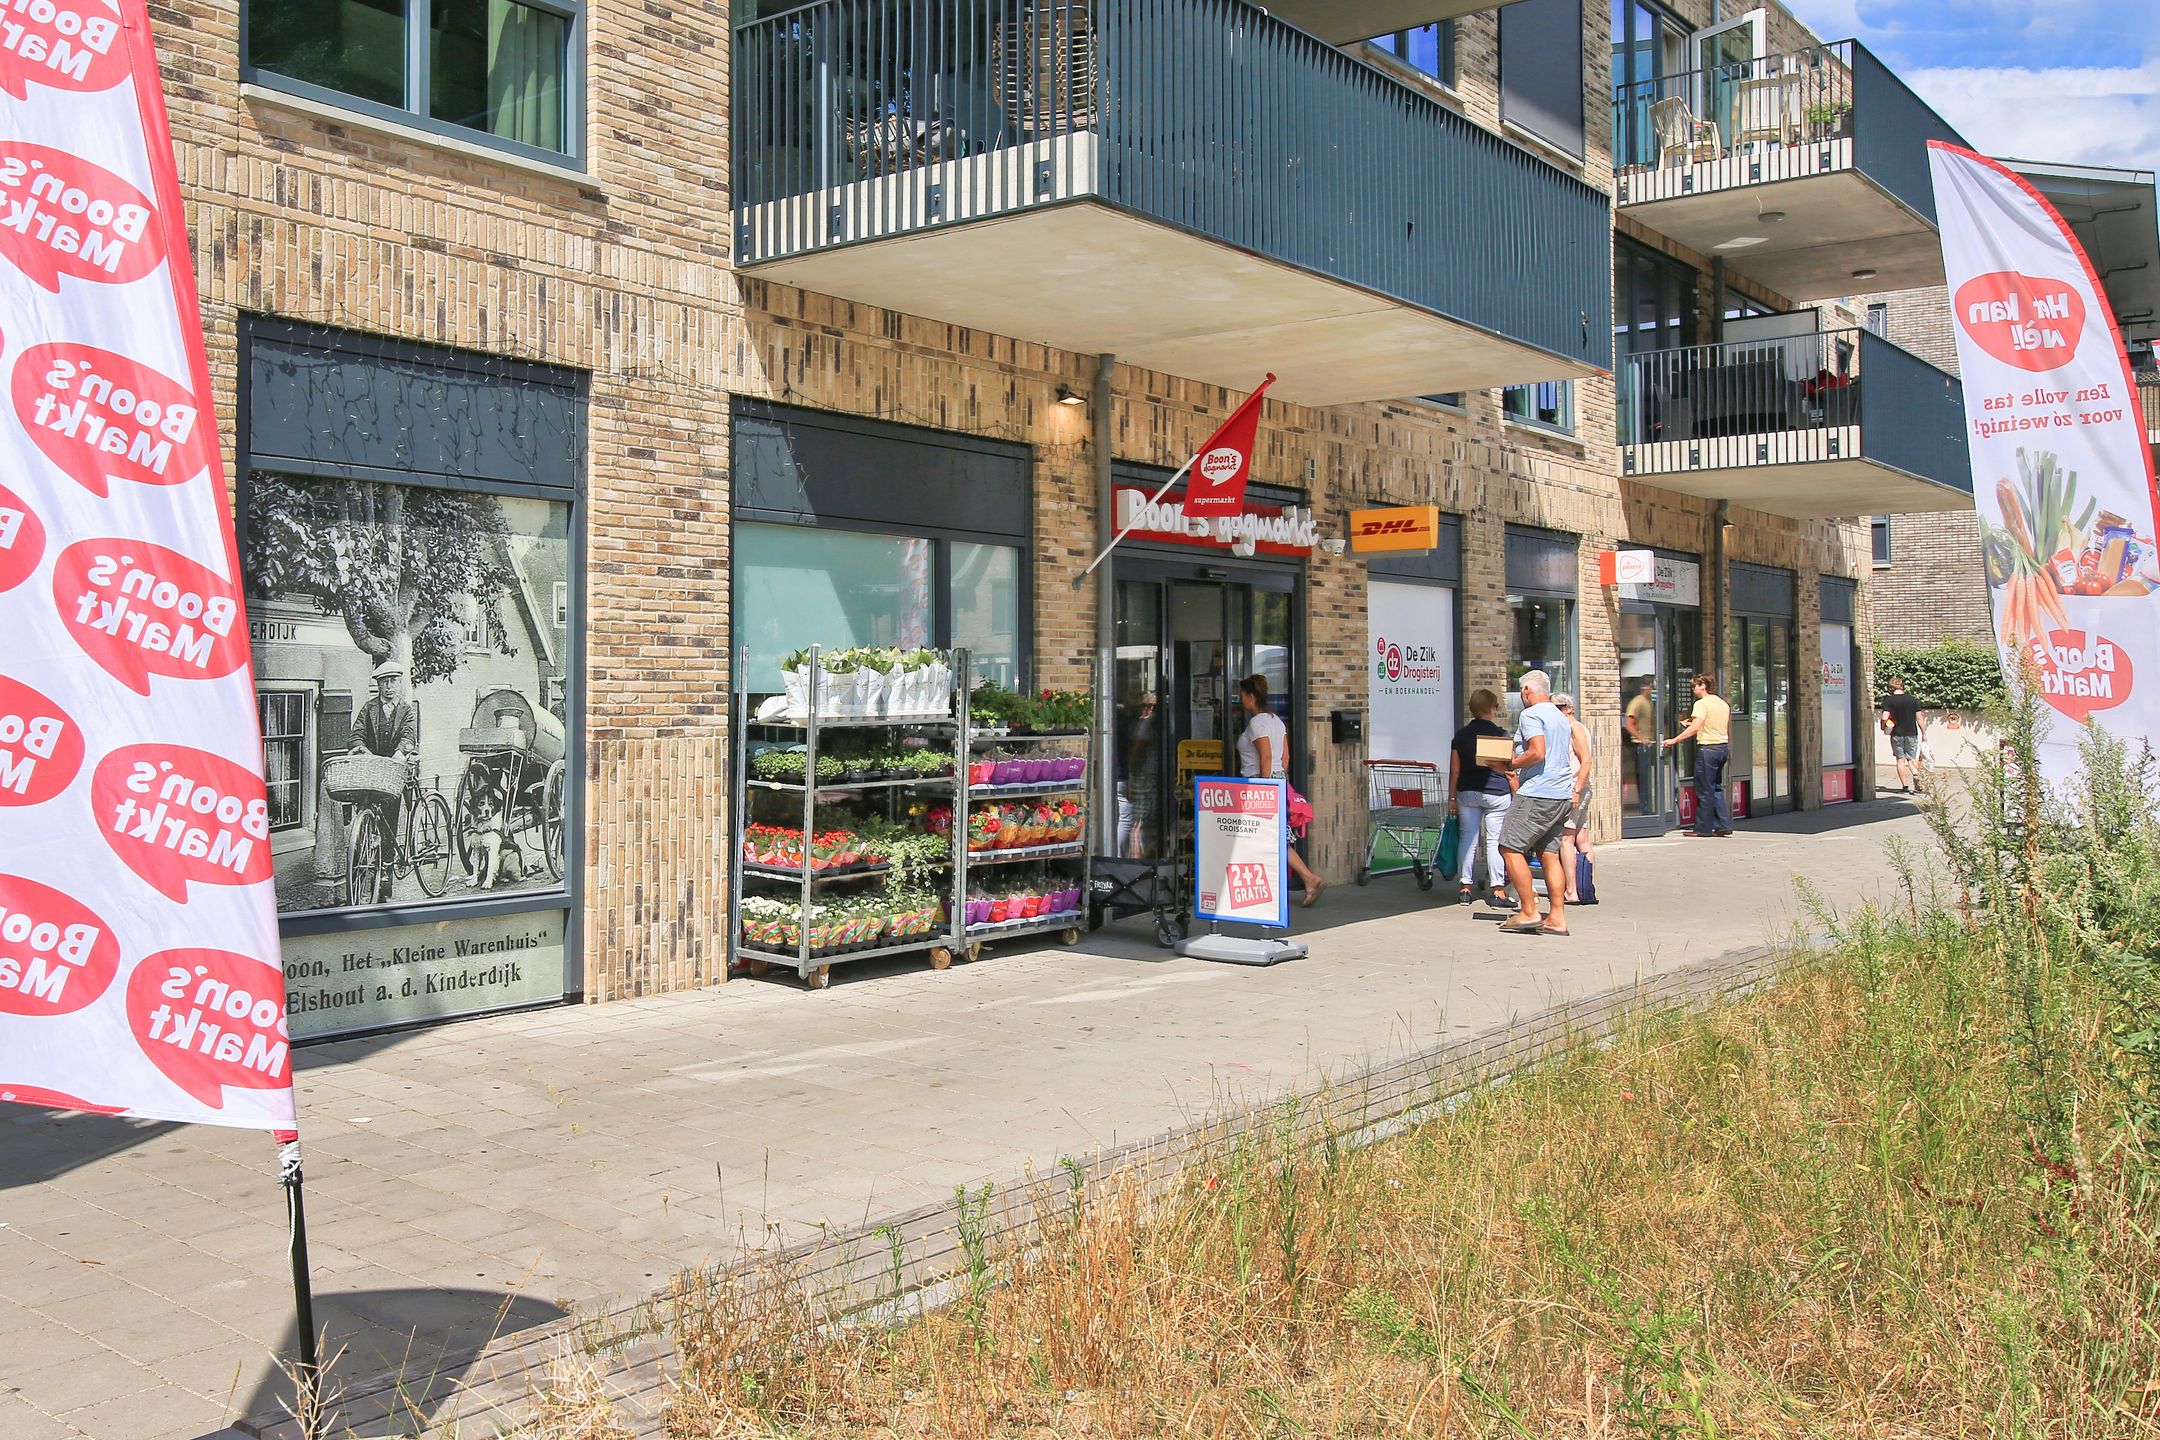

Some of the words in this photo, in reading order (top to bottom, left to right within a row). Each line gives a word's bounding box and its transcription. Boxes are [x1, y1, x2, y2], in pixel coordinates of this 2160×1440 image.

[1207, 453, 1237, 465] Boon's
[1203, 463, 1237, 475] dagmarkt
[1194, 496, 1236, 505] supermarkt
[1361, 519, 1418, 536] DHL
[1388, 652, 1399, 671] dz
[1406, 646, 1418, 662] De
[1420, 646, 1436, 662] Zilk
[1404, 665, 1441, 682] Drogisterij
[1384, 687, 1393, 695] EN
[1396, 687, 1435, 695] BOEKHANDEL
[1201, 787, 1234, 808] GIGA
[1240, 790, 1275, 800] GRATIS
[1241, 801, 1276, 810] VOORDEEL
[1217, 817, 1260, 827] ROOMBOTER
[1219, 825, 1258, 834] CROISSANT
[1231, 864, 1265, 887] 2+2
[1234, 885, 1269, 903] GRATIS
[282, 959, 330, 980] oon,
[342, 952, 373, 972] Het
[286, 984, 366, 1015] Elshout
[376, 985, 393, 1000] a.
[401, 977, 418, 997] d.
[426, 962, 522, 994] Kinderdijk
